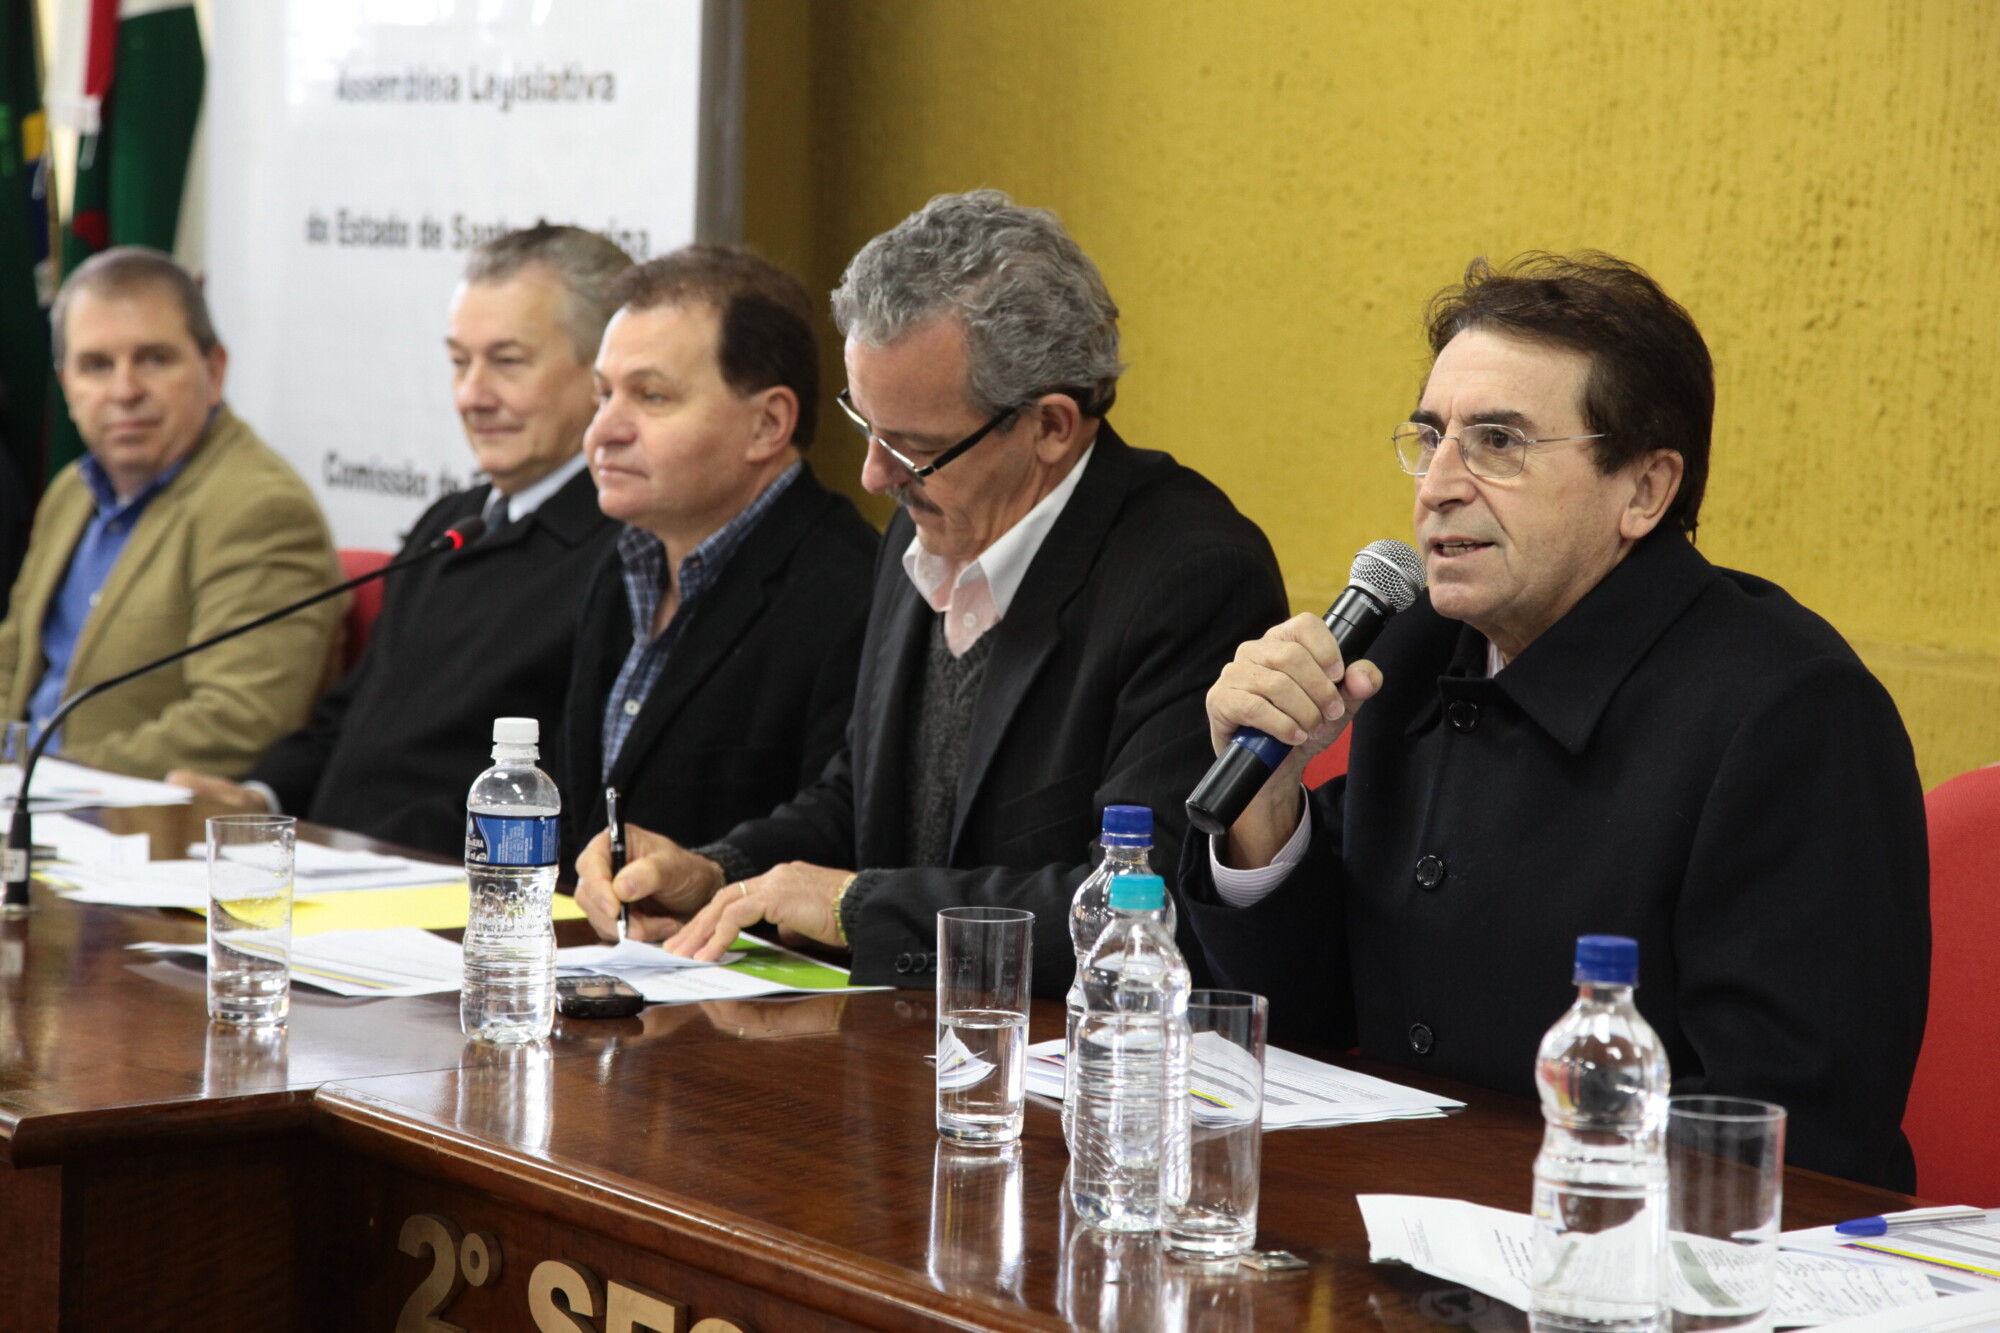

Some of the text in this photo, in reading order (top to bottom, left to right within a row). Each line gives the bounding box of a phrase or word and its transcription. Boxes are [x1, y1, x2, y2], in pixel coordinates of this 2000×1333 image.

[467, 63, 614, 110] Legislativa
[337, 206, 409, 246] Estado
[419, 211, 443, 249] de
[321, 449, 428, 500] Comissão
